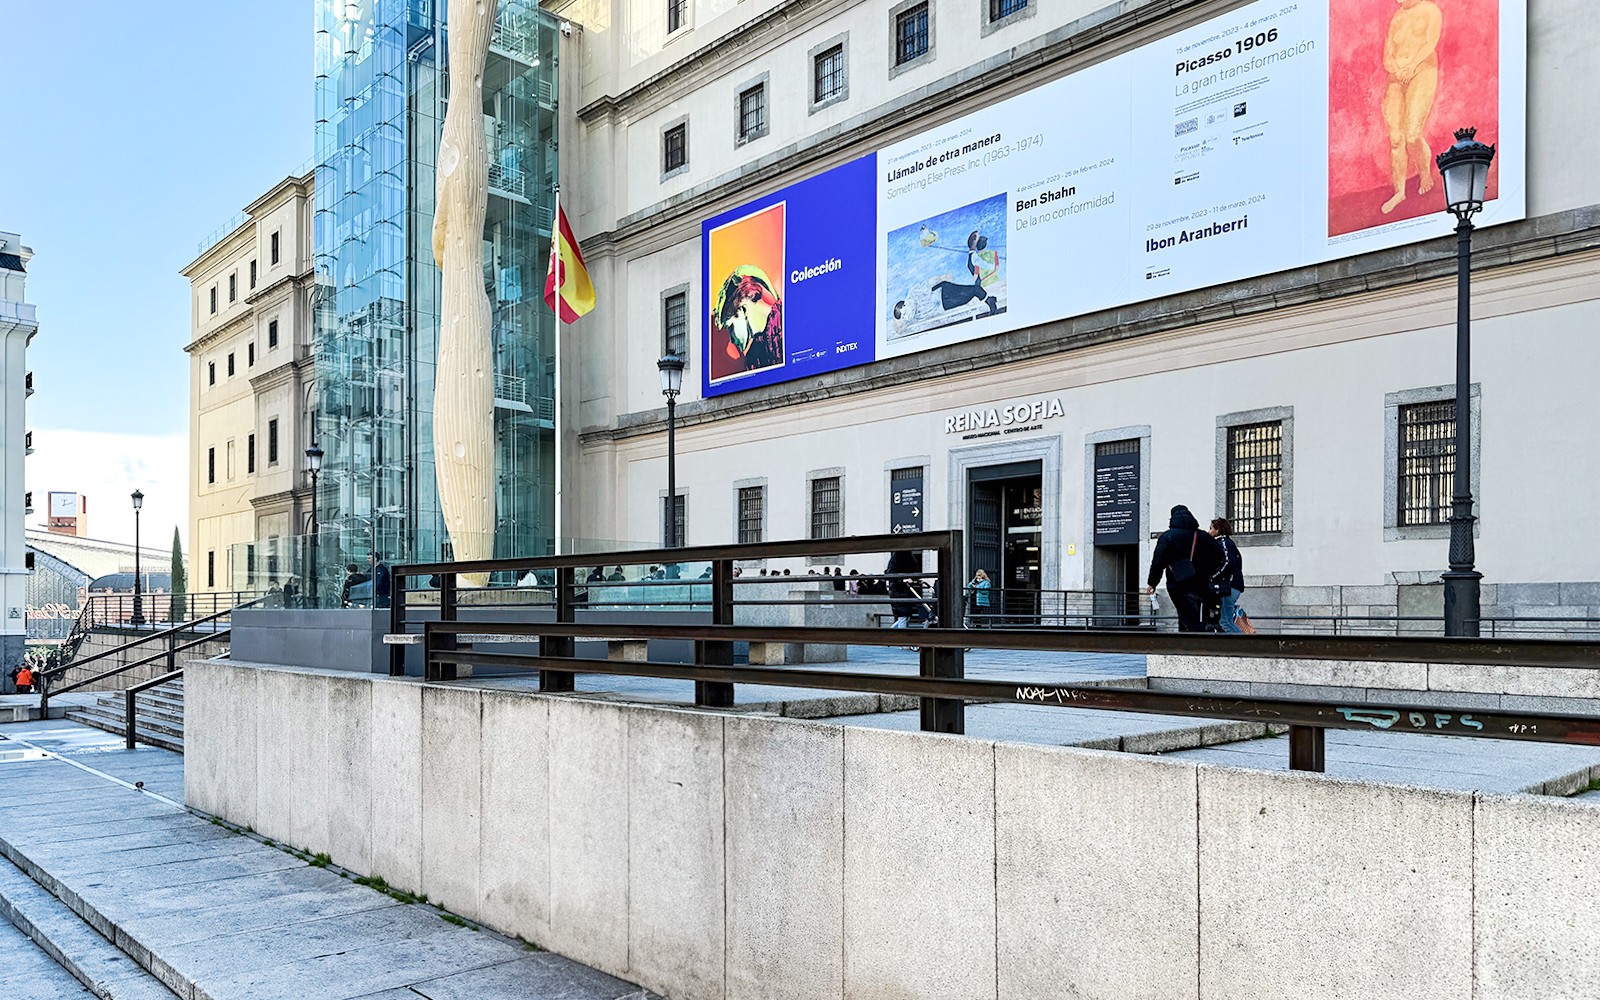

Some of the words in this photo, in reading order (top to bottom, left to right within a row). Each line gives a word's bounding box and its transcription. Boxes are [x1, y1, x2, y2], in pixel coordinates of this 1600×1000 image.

[1222, 26, 1239, 38] 2023
[1279, 4, 1298, 16] 2024
[1175, 48, 1232, 77] Picasso
[1235, 28, 1278, 54] 1906
[1175, 83, 1189, 97] La
[1192, 74, 1217, 94] gran
[1220, 39, 1315, 80] transformación
[887, 161, 924, 183] Llámalo
[926, 156, 938, 168] de
[940, 148, 960, 162] otra
[962, 133, 1001, 154] manera
[887, 178, 926, 200] Something
[928, 172, 942, 185] Else
[1016, 198, 1037, 213] Ben
[1040, 185, 1076, 205] Shahn
[1016, 217, 1028, 231] De
[1030, 212, 1038, 227] la
[1039, 211, 1051, 224] no
[1052, 192, 1115, 220] conformidad
[1191, 209, 1208, 219] 2023
[1248, 194, 1266, 204] 2024
[1146, 236, 1175, 252] Ibon
[1179, 214, 1248, 244] Aranberri
[790, 257, 842, 284] Colección
[836, 342, 858, 354] INDITEX
[944, 408, 1000, 434] REINA
[1002, 398, 1064, 425] SOFIA
